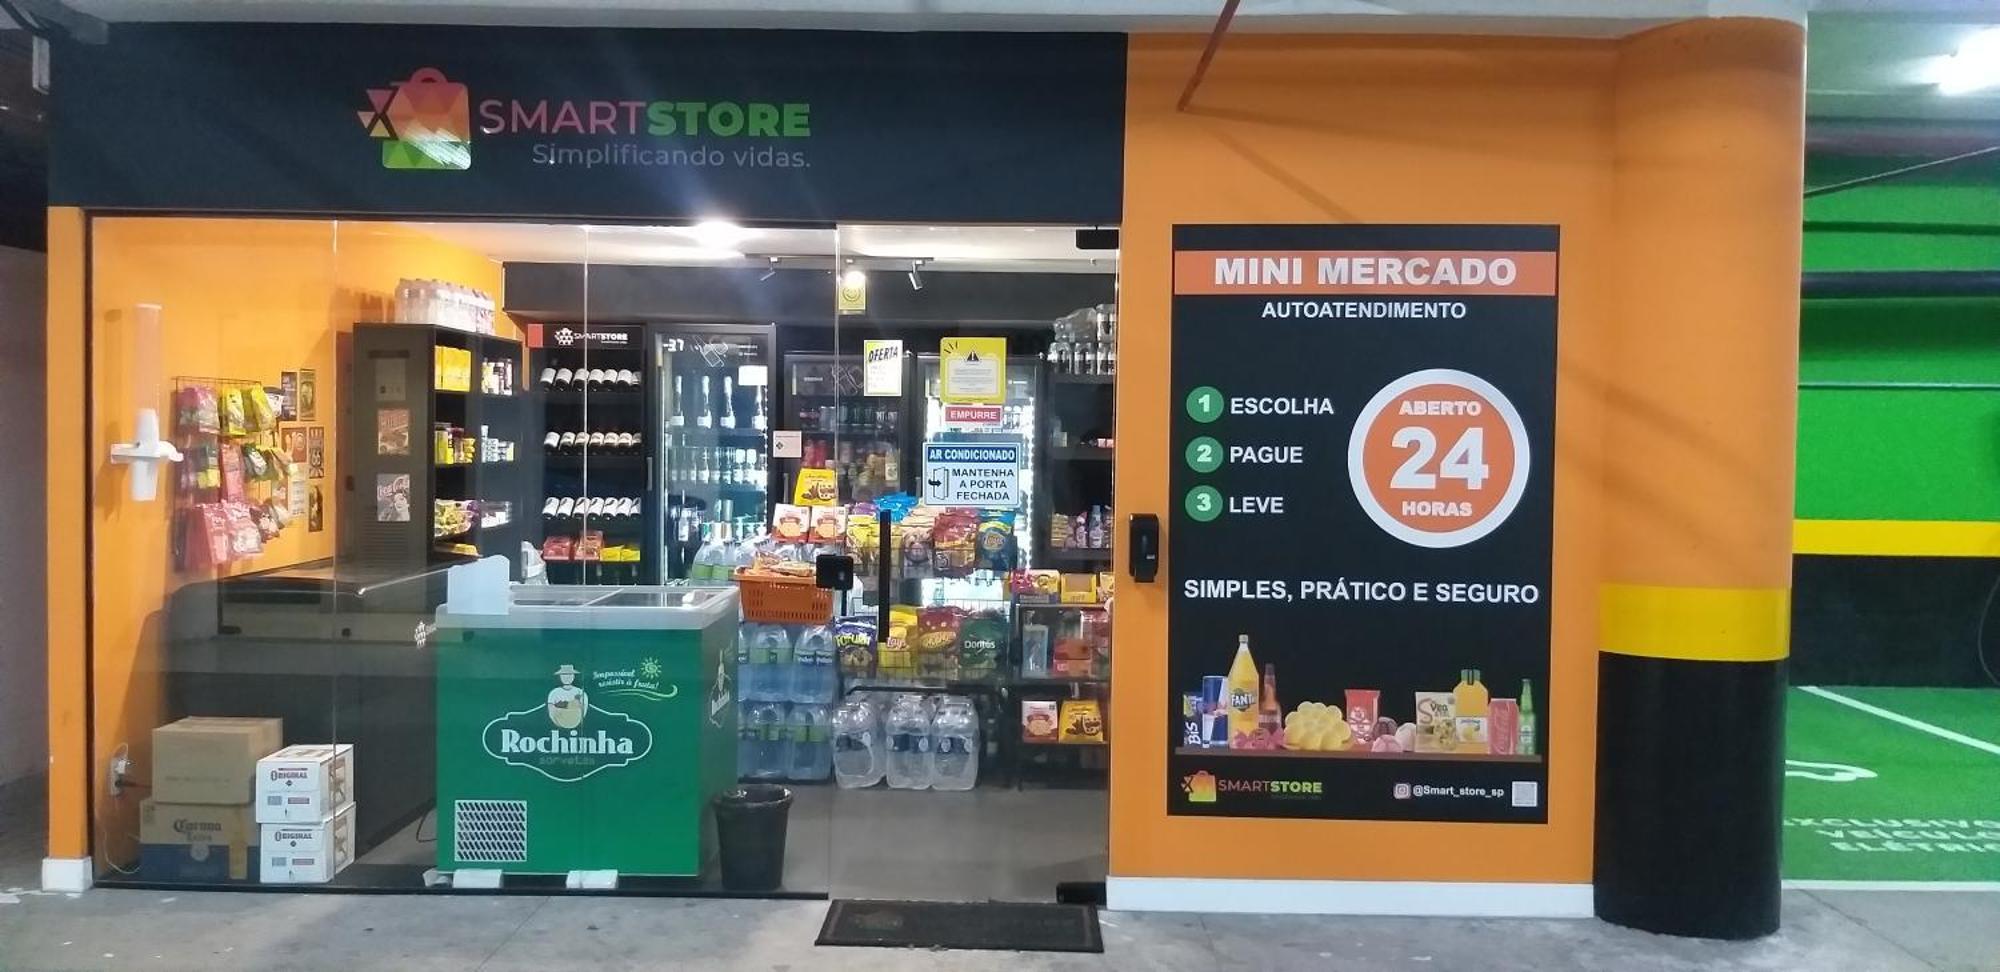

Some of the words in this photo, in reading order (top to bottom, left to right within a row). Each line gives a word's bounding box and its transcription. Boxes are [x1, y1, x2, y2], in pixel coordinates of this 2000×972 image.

[479, 99, 811, 138] SMARTSTORE
[532, 142, 725, 170] Simplificando
[732, 144, 811, 169] vidas.
[1214, 257, 1303, 285] MINI
[1317, 257, 1517, 286] MERCADO
[1262, 301, 1467, 319] AUTOATENDIMENTO
[868, 346, 898, 363] OFERTA
[1197, 394, 1211, 413] 1
[1230, 397, 1335, 415] ESCOLHA
[1398, 400, 1481, 417] ABERTO
[950, 410, 997, 420] EMPURRE
[929, 449, 943, 460] AR
[944, 449, 1015, 461] CONDICIONADO
[1196, 445, 1212, 464] 2
[1229, 446, 1303, 464] PAGUE
[1389, 426, 1489, 491] 24
[952, 468, 1014, 477] MANTENHA
[959, 480, 967, 488] A
[970, 480, 1007, 489] PORTA
[956, 491, 1010, 501] FECHADA
[1196, 494, 1212, 512] 3
[1229, 496, 1284, 514] LEVE
[1401, 500, 1472, 517] HORAS
[1184, 579, 1293, 602] SIMPLES,
[1300, 577, 1406, 601] PRÁTICO
[1413, 581, 1428, 601] E
[1435, 582, 1539, 604] SEGURO
[501, 728, 634, 754] Rochinha
[1218, 779, 1323, 793] SMARTSTORE
[1412, 784, 1505, 798] @Smart_store_sp
[173, 818, 222, 833] Corona
